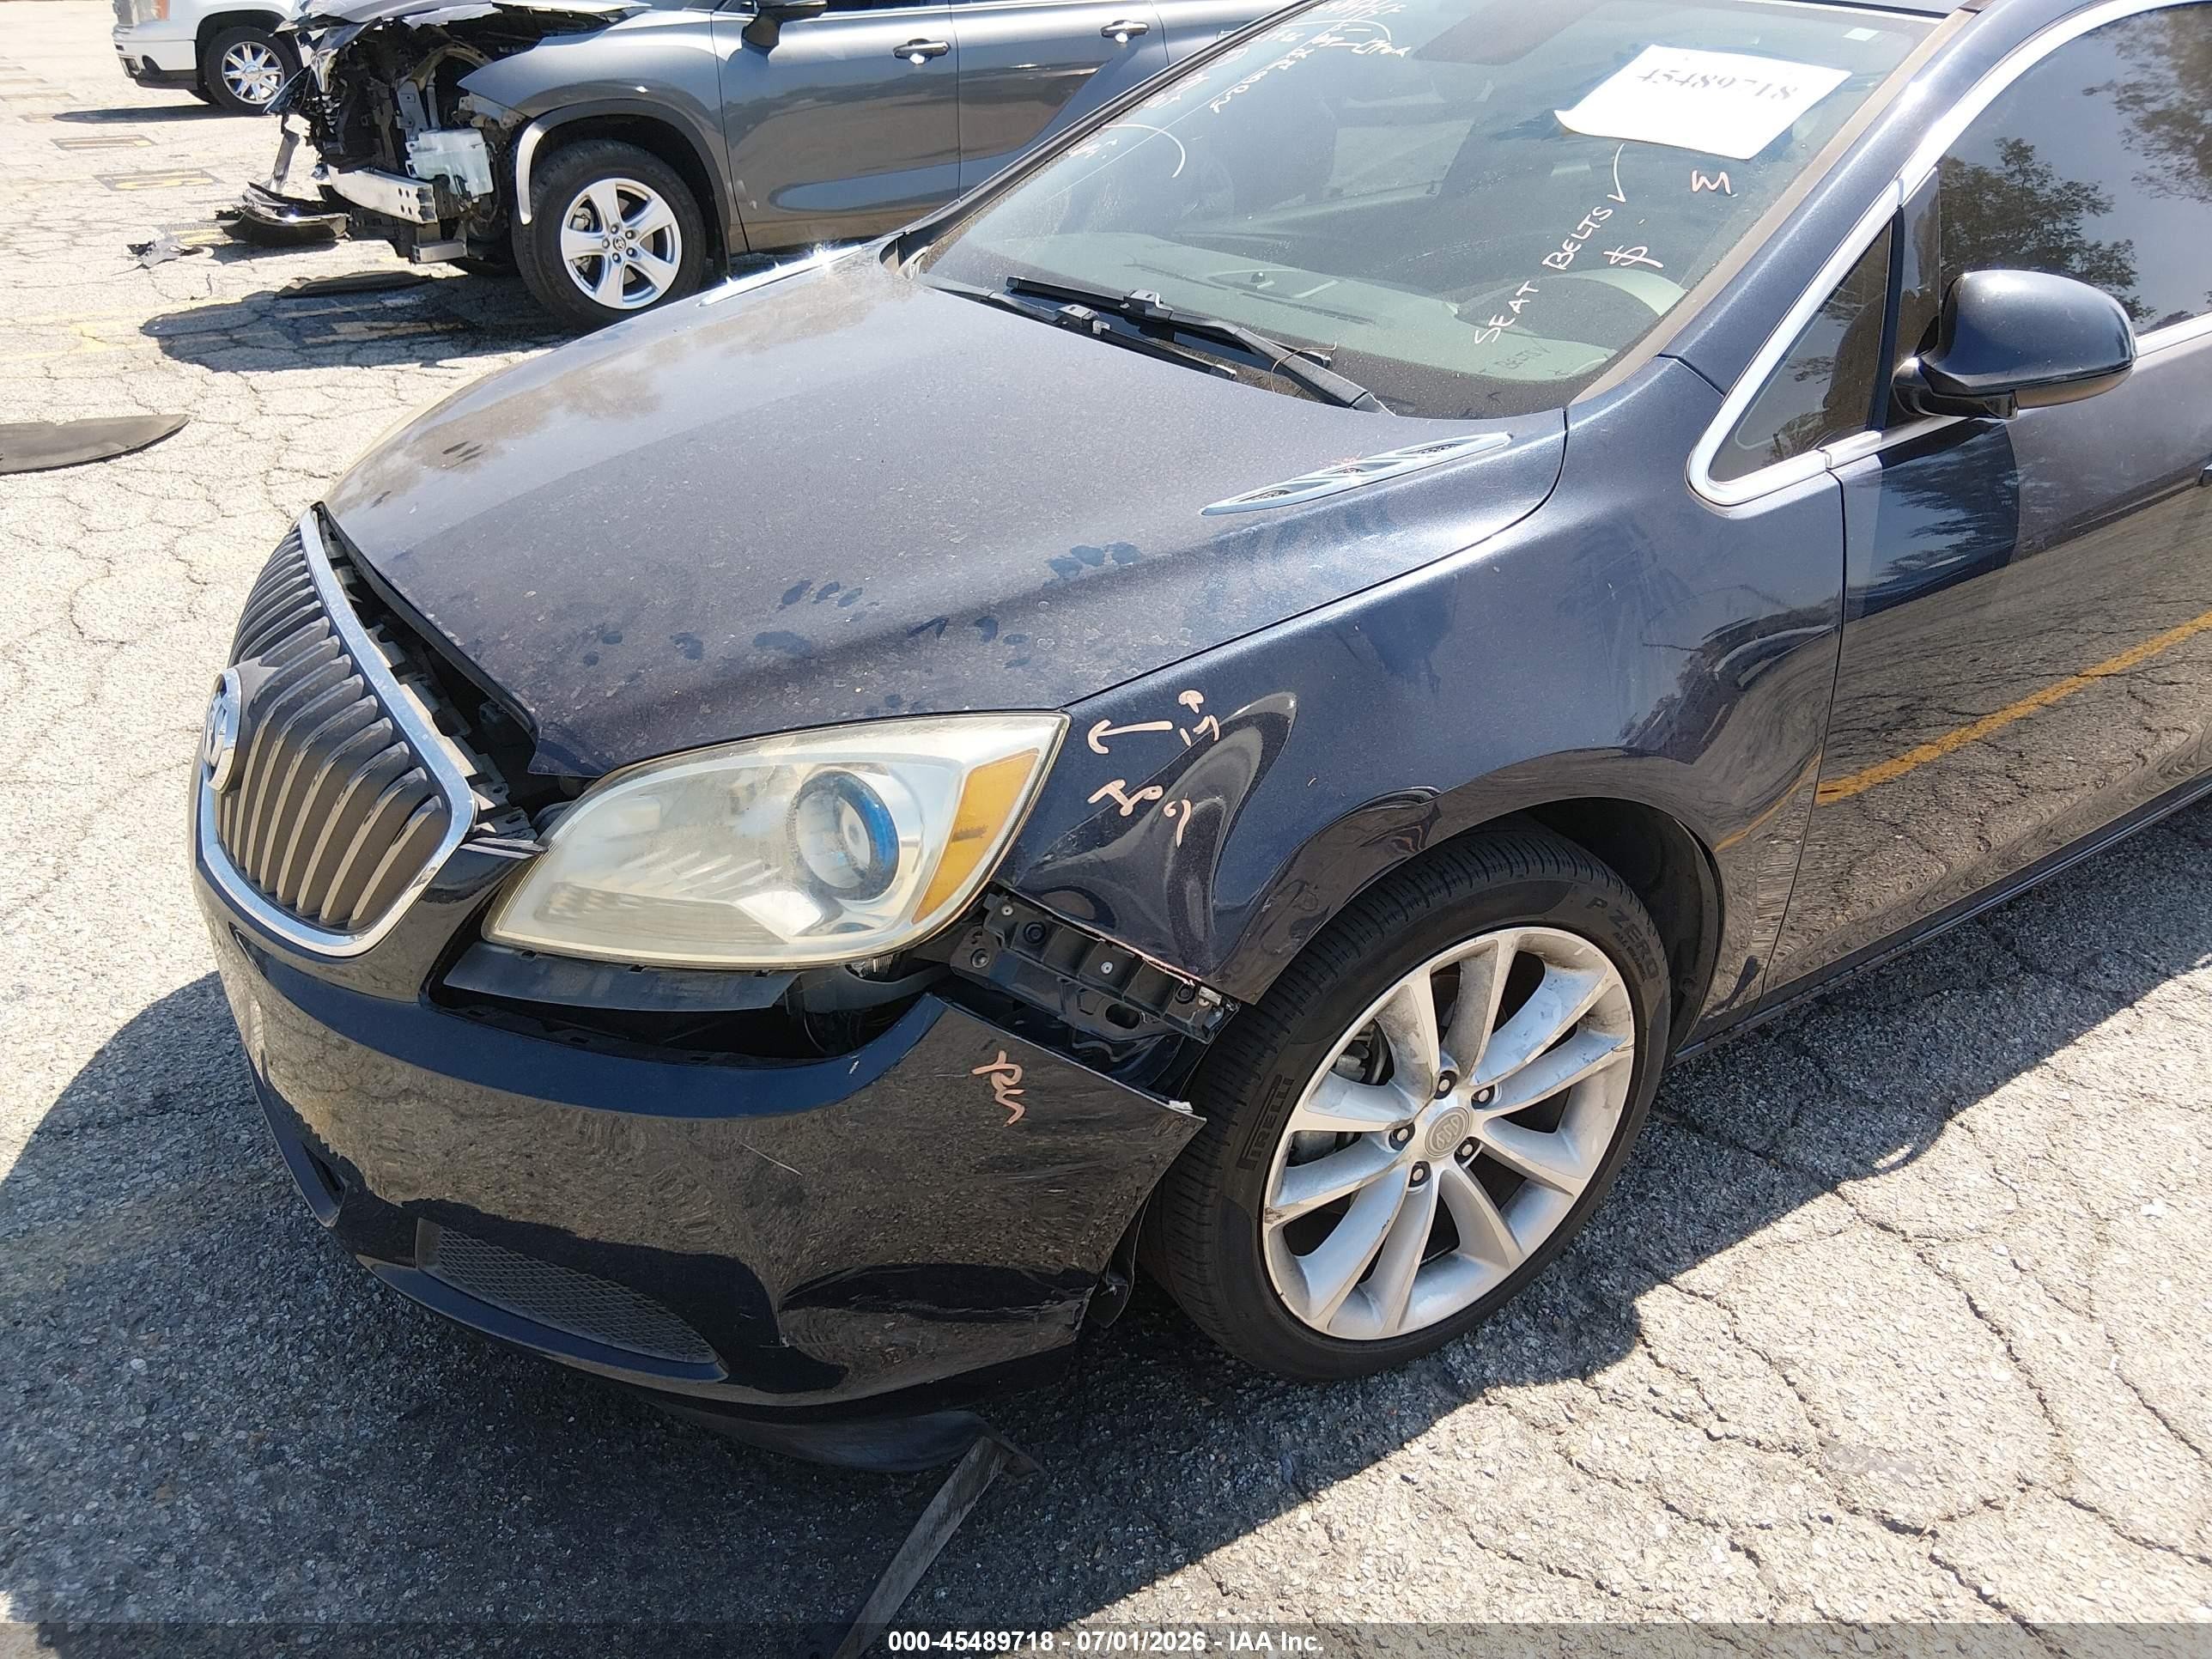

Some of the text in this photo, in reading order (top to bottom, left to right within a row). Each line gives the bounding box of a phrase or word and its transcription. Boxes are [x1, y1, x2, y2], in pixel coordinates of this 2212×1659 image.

[1635, 67, 1800, 100] 45489718
[1474, 206, 1613, 344] SEAT BELTS
